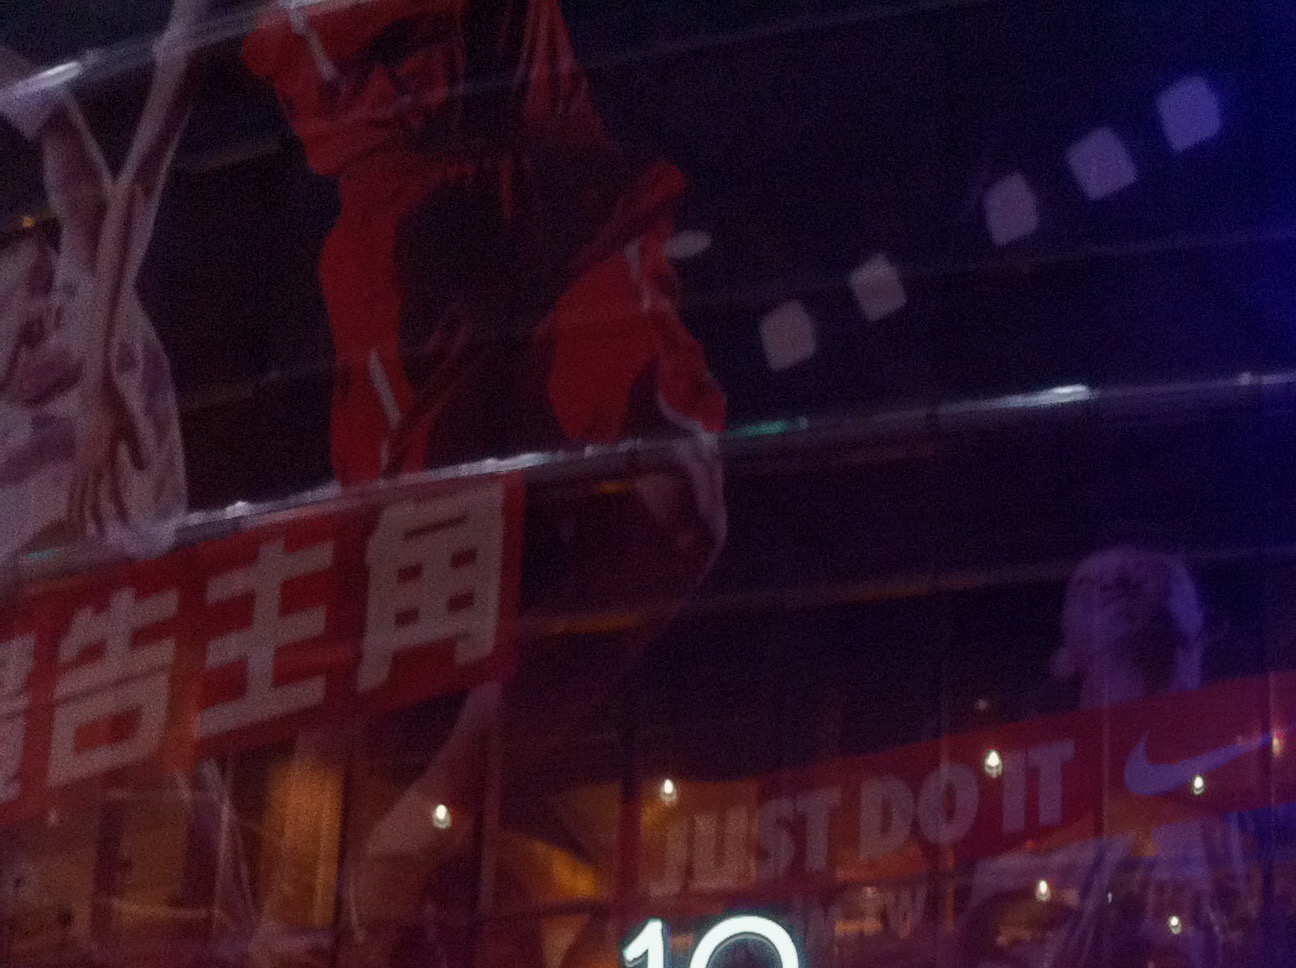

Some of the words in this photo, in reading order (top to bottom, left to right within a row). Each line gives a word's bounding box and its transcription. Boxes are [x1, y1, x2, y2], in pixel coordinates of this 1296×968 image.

[647, 786, 840, 899] JUST
[858, 761, 981, 862] DO
[1001, 738, 1076, 833] IT
